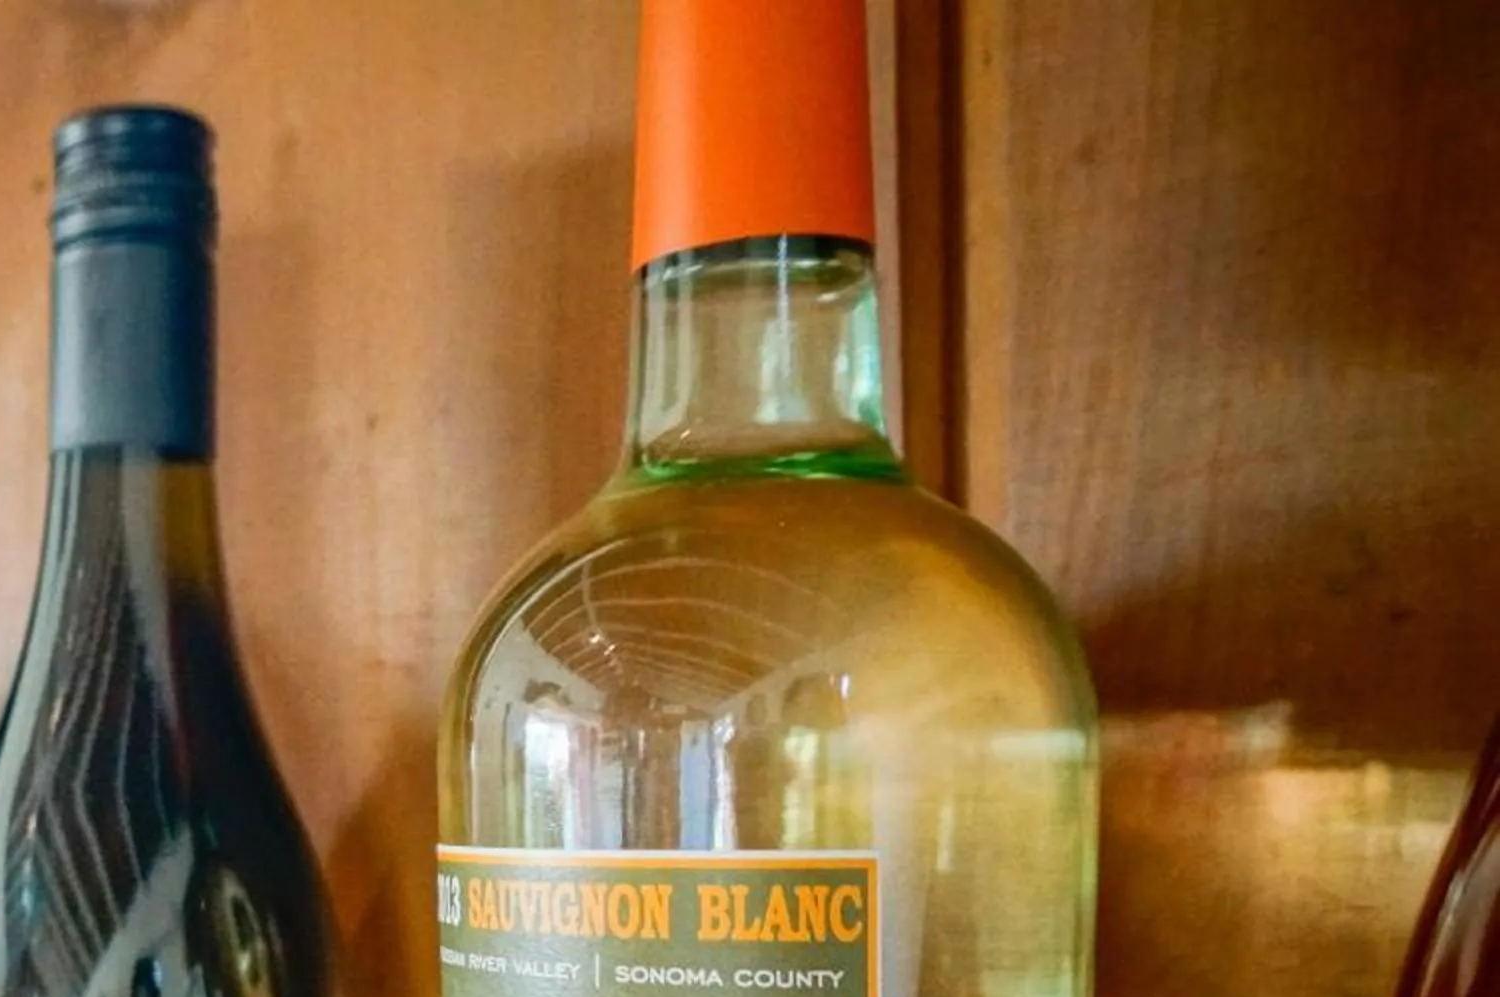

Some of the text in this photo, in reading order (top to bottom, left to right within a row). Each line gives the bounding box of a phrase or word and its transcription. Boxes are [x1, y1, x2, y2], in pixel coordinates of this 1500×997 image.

[468, 877, 673, 940] SAUVIGNON
[696, 883, 865, 943] BLANC
[469, 952, 506, 975] RIVER
[512, 956, 581, 981] VALLEY
[614, 964, 723, 988] SONOMA
[733, 968, 845, 990] COUNTY
